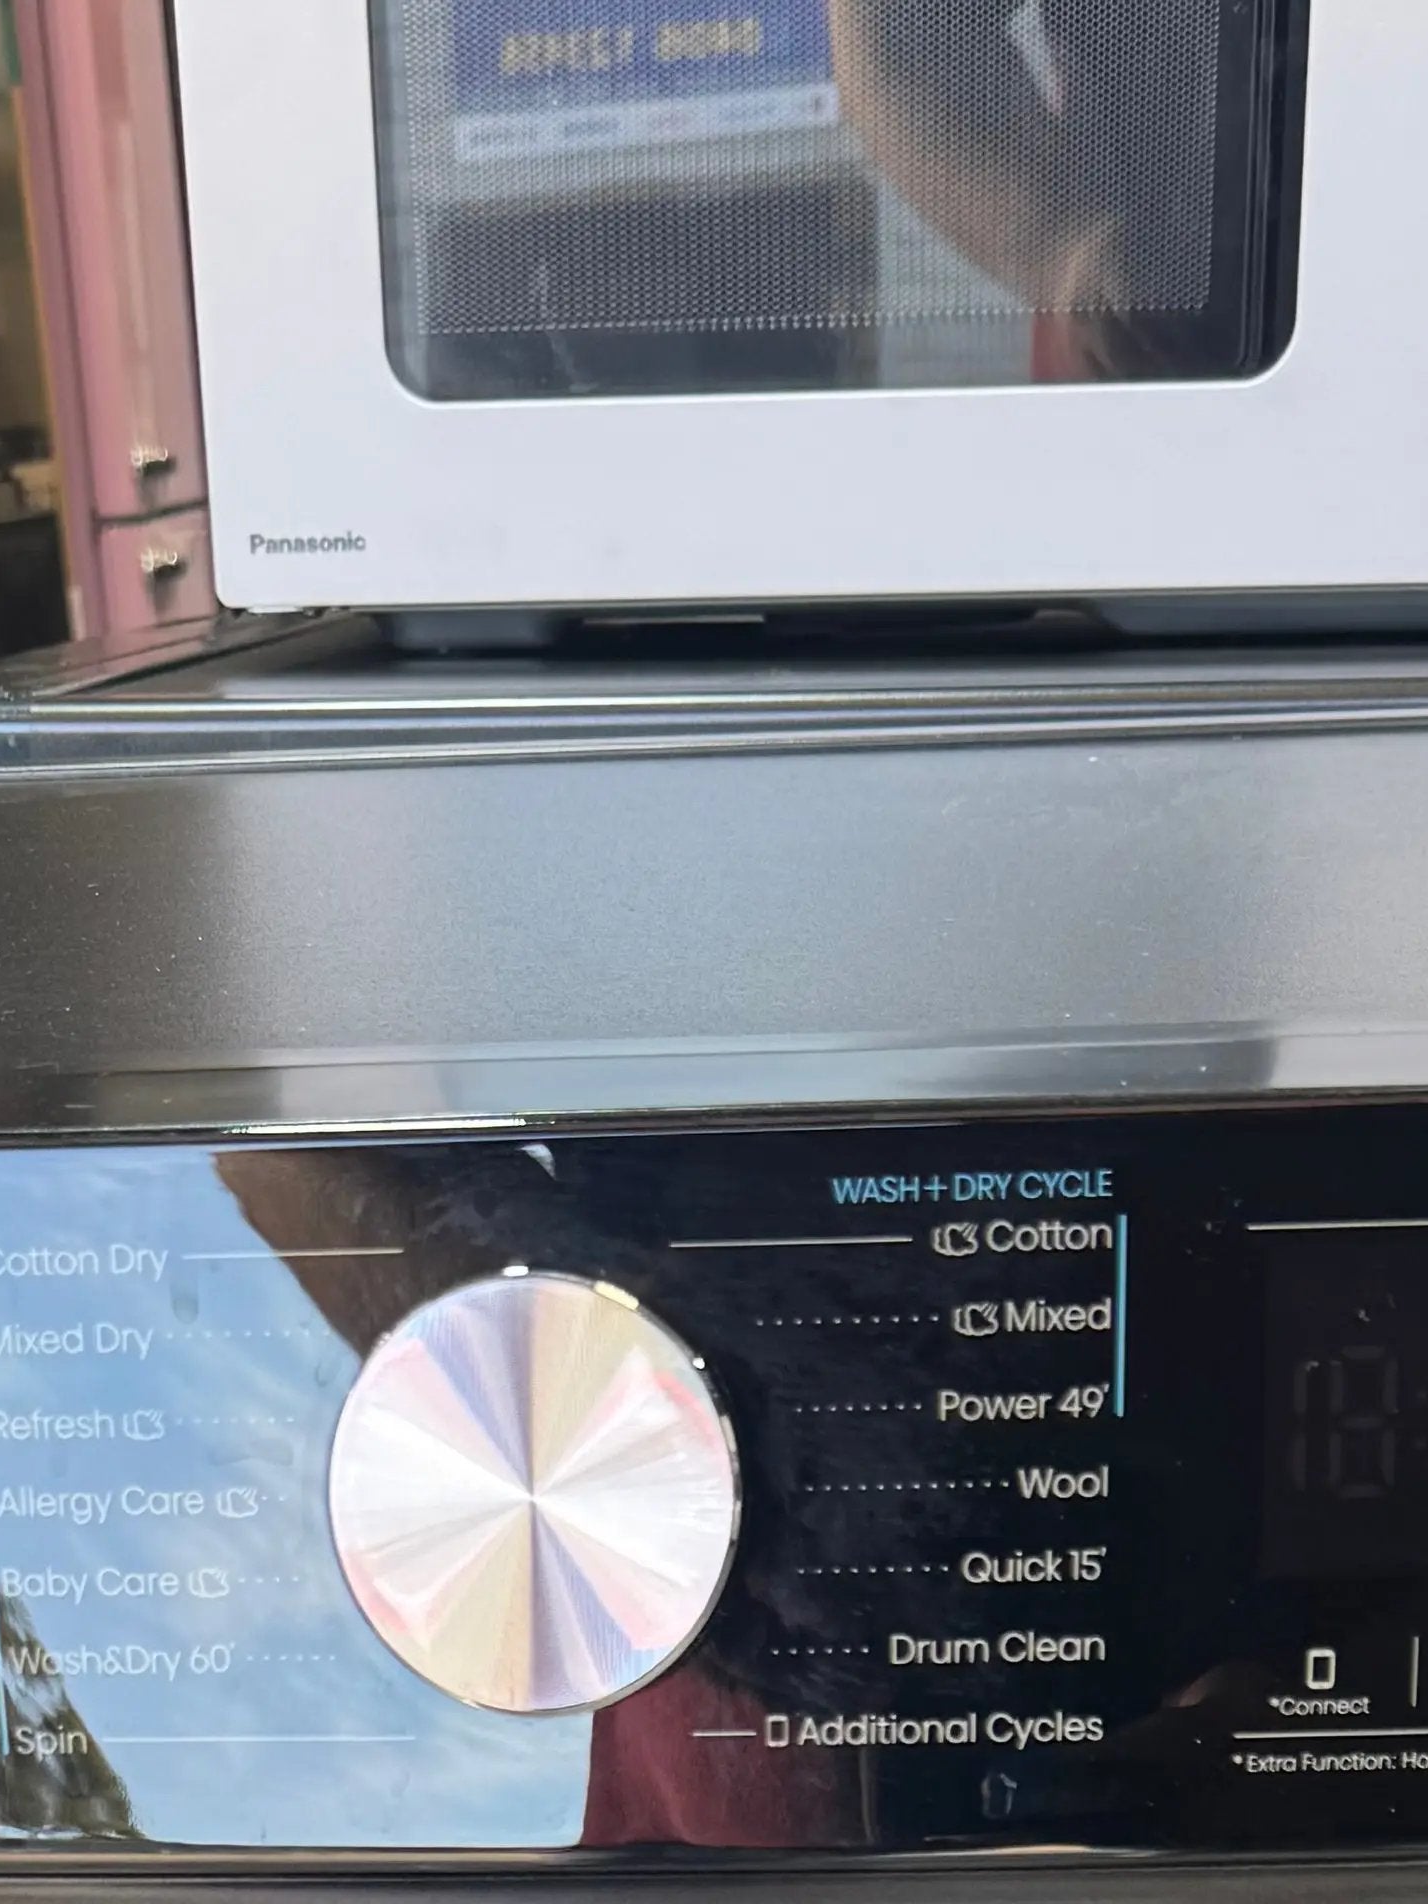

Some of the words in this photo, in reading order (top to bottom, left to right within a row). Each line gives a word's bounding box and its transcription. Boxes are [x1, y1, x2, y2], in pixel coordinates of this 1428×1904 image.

[249, 529, 367, 556] Panasonic
[1019, 1170, 1114, 1200] CYCLE
[985, 1219, 1113, 1253] Cotton
[109, 1244, 170, 1283] Dry
[1004, 1297, 1113, 1333] Mixed
[95, 1322, 154, 1360] Dry
[937, 1388, 1053, 1423] Power
[1017, 1464, 1110, 1500] Wool
[121, 1485, 205, 1516] Care
[961, 1550, 1062, 1584] Quick
[1, 1566, 89, 1606] Baby
[96, 1567, 180, 1597] Care
[8, 1643, 181, 1681] Wash&Dry
[888, 1632, 991, 1666] Drum
[998, 1629, 1107, 1664] Clean
[13, 1723, 89, 1760] Spin
[796, 1710, 977, 1747] Additional
[985, 1710, 1105, 1750] Cycles
[1300, 1751, 1397, 1772] Function:
